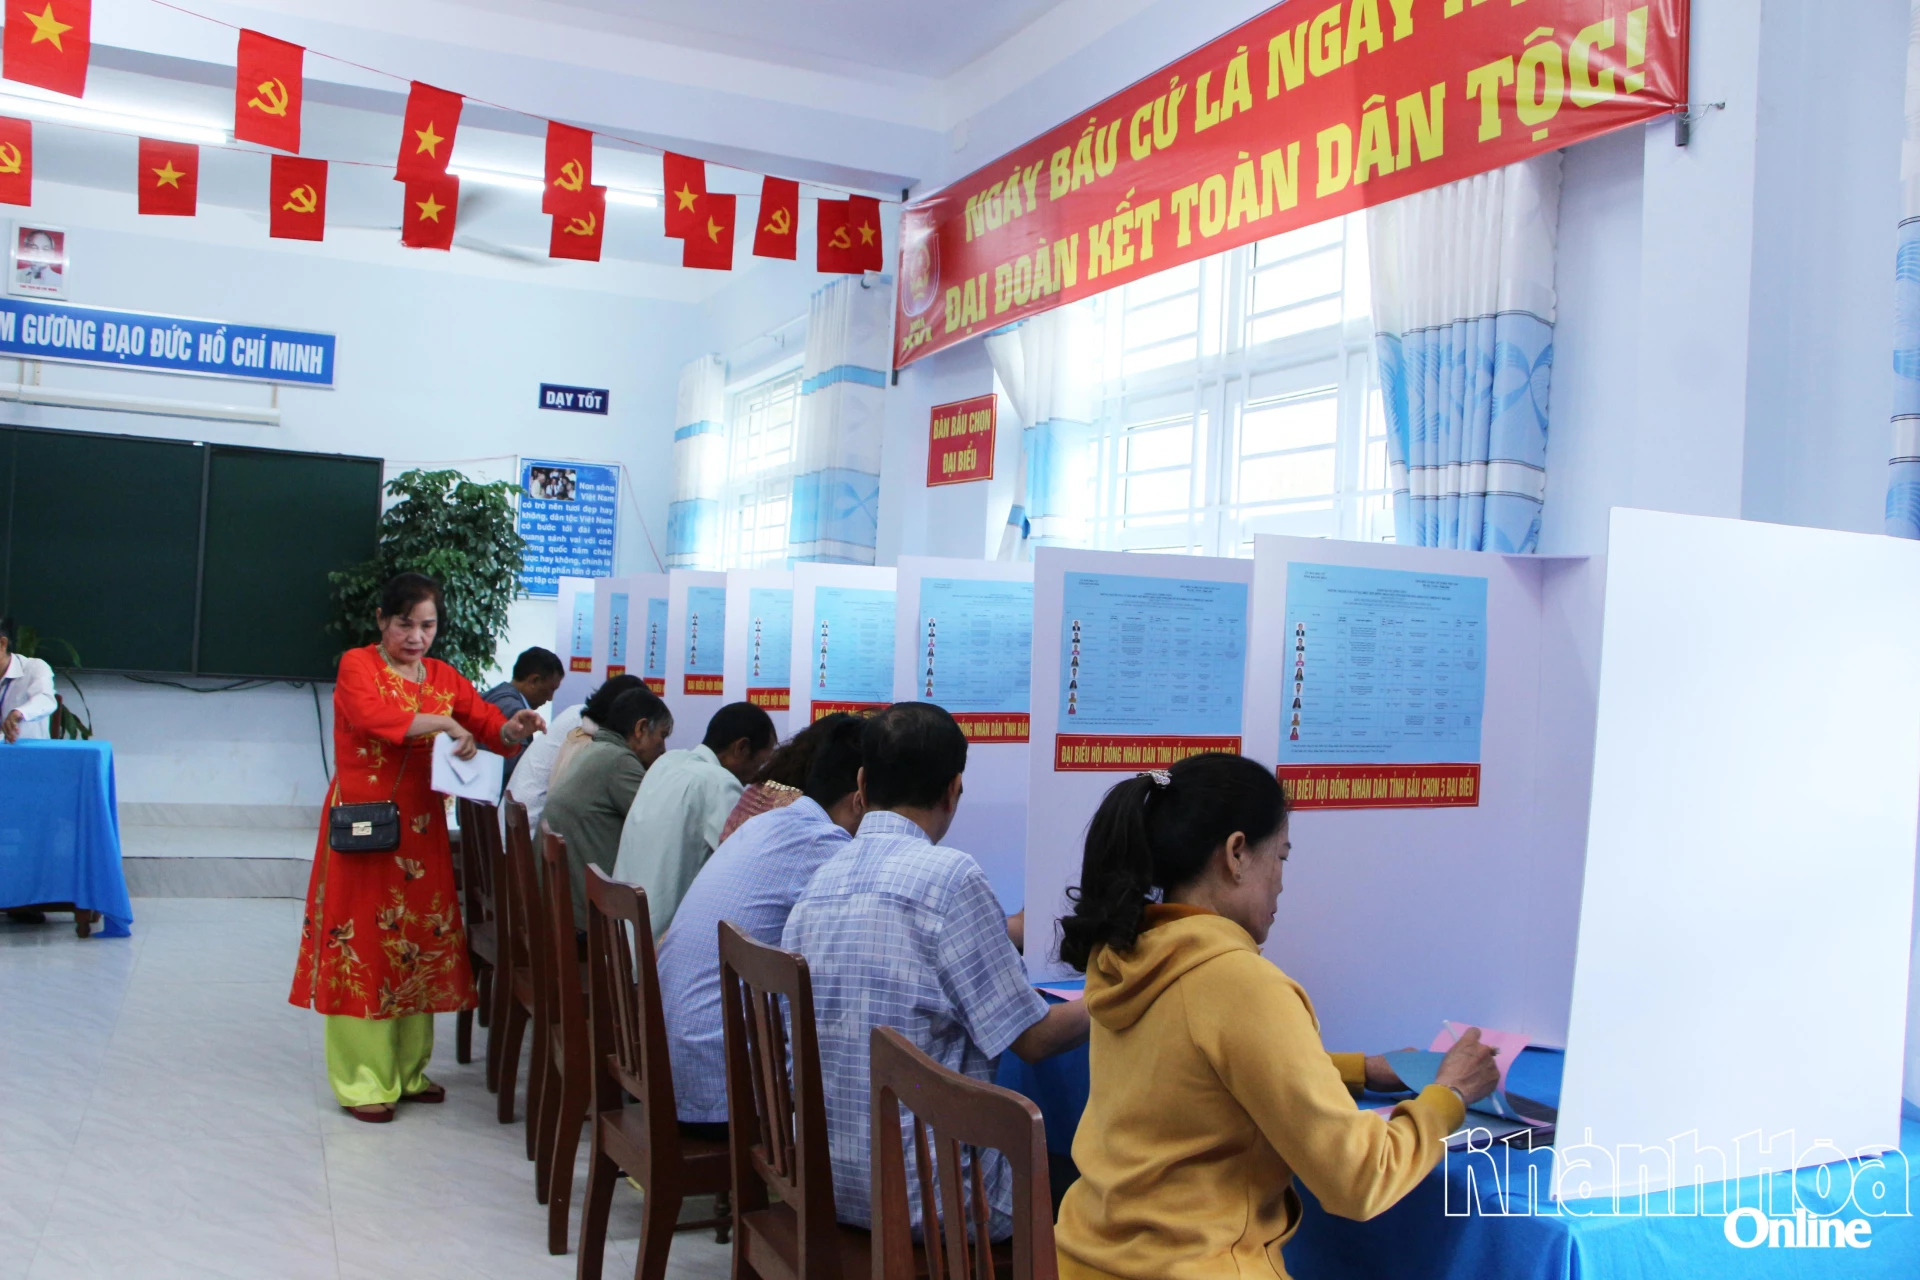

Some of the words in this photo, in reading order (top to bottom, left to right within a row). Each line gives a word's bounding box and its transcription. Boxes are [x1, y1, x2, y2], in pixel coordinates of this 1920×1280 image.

[965, 160, 1043, 243] NGÀY
[1050, 117, 1121, 201] BẦU
[1129, 76, 1187, 161] CỬ
[1195, 46, 1252, 133] LÀ
[945, 274, 987, 335] ĐẠI
[995, 233, 1079, 314] ĐOÀN
[1088, 187, 1160, 279] KẾT
[1171, 141, 1300, 247] TOÀN
[1316, 82, 1446, 199] DÂN
[1466, 5, 1649, 142] TỘC!
[22, 313, 97, 350] GƯƠNG
[102, 322, 144, 359] ĐẠO
[150, 324, 192, 361] ĐỨC
[199, 326, 227, 364] HỒ
[232, 333, 267, 368] CHÍ
[270, 341, 324, 375] MINH
[545, 391, 574, 408] DẠY
[577, 390, 602, 409] TỐT
[969, 408, 991, 436] CHỌN
[942, 451, 957, 477] ĐẠI
[958, 440, 977, 472] BIỂU
[522, 501, 532, 509] có
[599, 506, 614, 515] hay
[581, 493, 596, 502] Việt
[598, 494, 614, 502] Nam
[521, 522, 531, 530] có
[595, 516, 613, 524] Nam
[539, 555, 554, 564] hay
[1061, 745, 1073, 767] ĐẠI
[1074, 739, 1090, 763] BIỂU
[1091, 742, 1103, 767] HỘI
[1104, 740, 1122, 763] ĐỒNG
[1123, 743, 1141, 763] NHÂN
[1142, 743, 1156, 763] DÂN
[1157, 740, 1171, 763] TỈNH
[1296, 770, 1315, 800] BIỂU
[1315, 774, 1328, 805] HỘI
[1329, 771, 1350, 800] ĐỒNG
[1351, 773, 1372, 799] NHÂN
[1373, 773, 1388, 799] DÂN
[1389, 770, 1405, 798] TỈNH
[1406, 770, 1420, 798] BẦU
[1421, 777, 1440, 803] CHỌN
[1440, 777, 1446, 797] 5
[1446, 777, 1458, 802] ĐẠI
[1458, 768, 1475, 797] BIỂU
